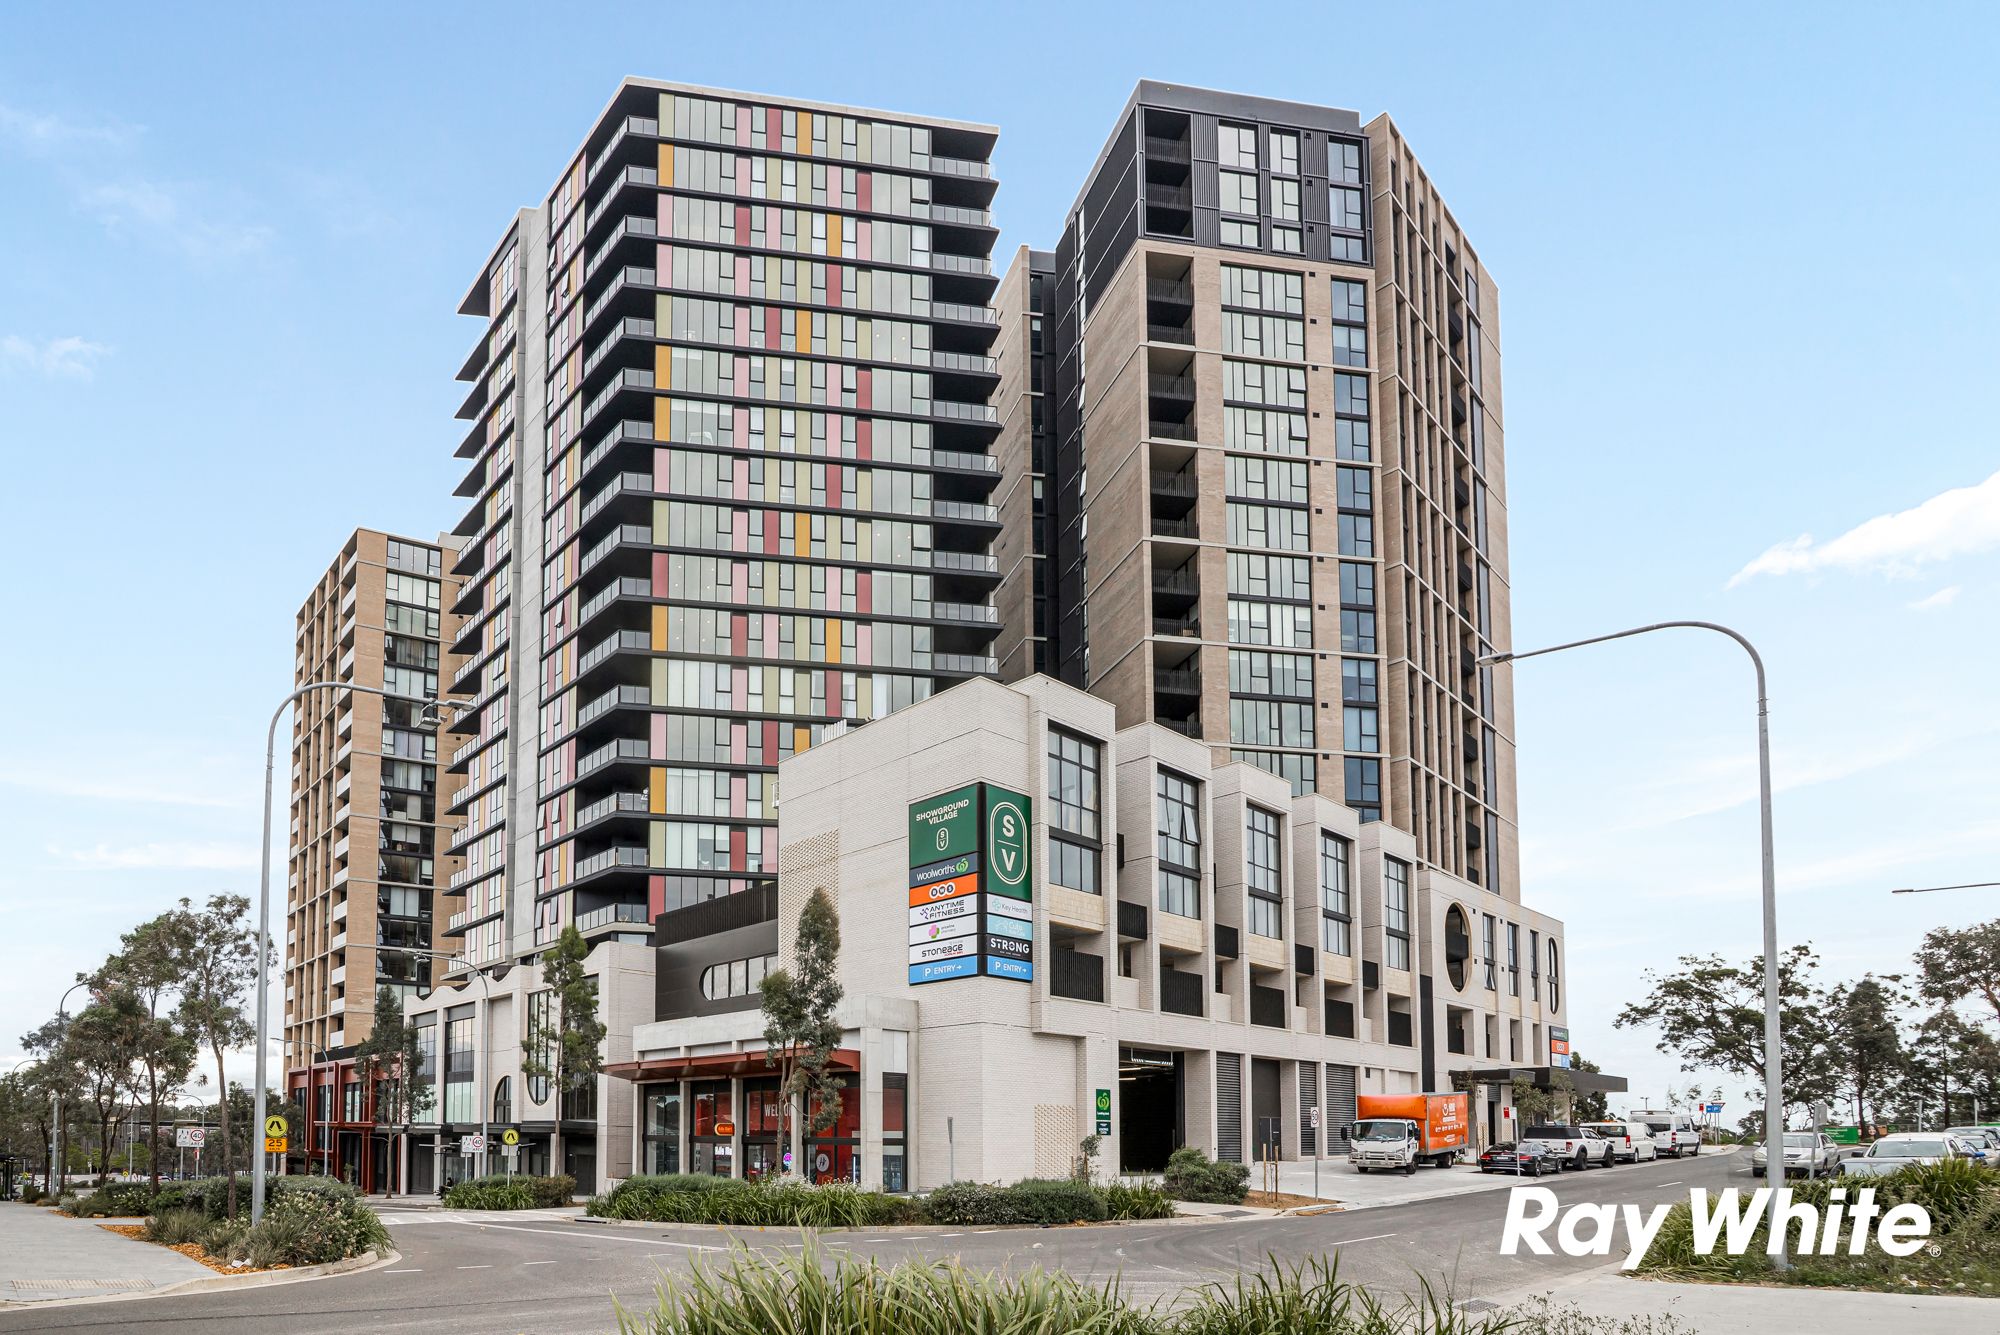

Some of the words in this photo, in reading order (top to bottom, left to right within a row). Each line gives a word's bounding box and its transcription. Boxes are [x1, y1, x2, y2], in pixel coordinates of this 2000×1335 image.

[916, 799, 969, 821] SHOWGROUND
[928, 810, 958, 825] VILLAGE
[1002, 814, 1015, 838] S
[1001, 848, 1016, 872] V
[916, 865, 956, 881] Woolworths
[929, 900, 965, 913] ANYTIME
[929, 907, 965, 920] FITNESS
[1001, 904, 1011, 912] Key
[990, 938, 1030, 954] STRONG
[924, 967, 931, 977] P
[934, 965, 956, 975] ENTRY
[995, 961, 1001, 971] P
[1003, 963, 1021, 973] ENTRY
[268, 1139, 283, 1147] 25
